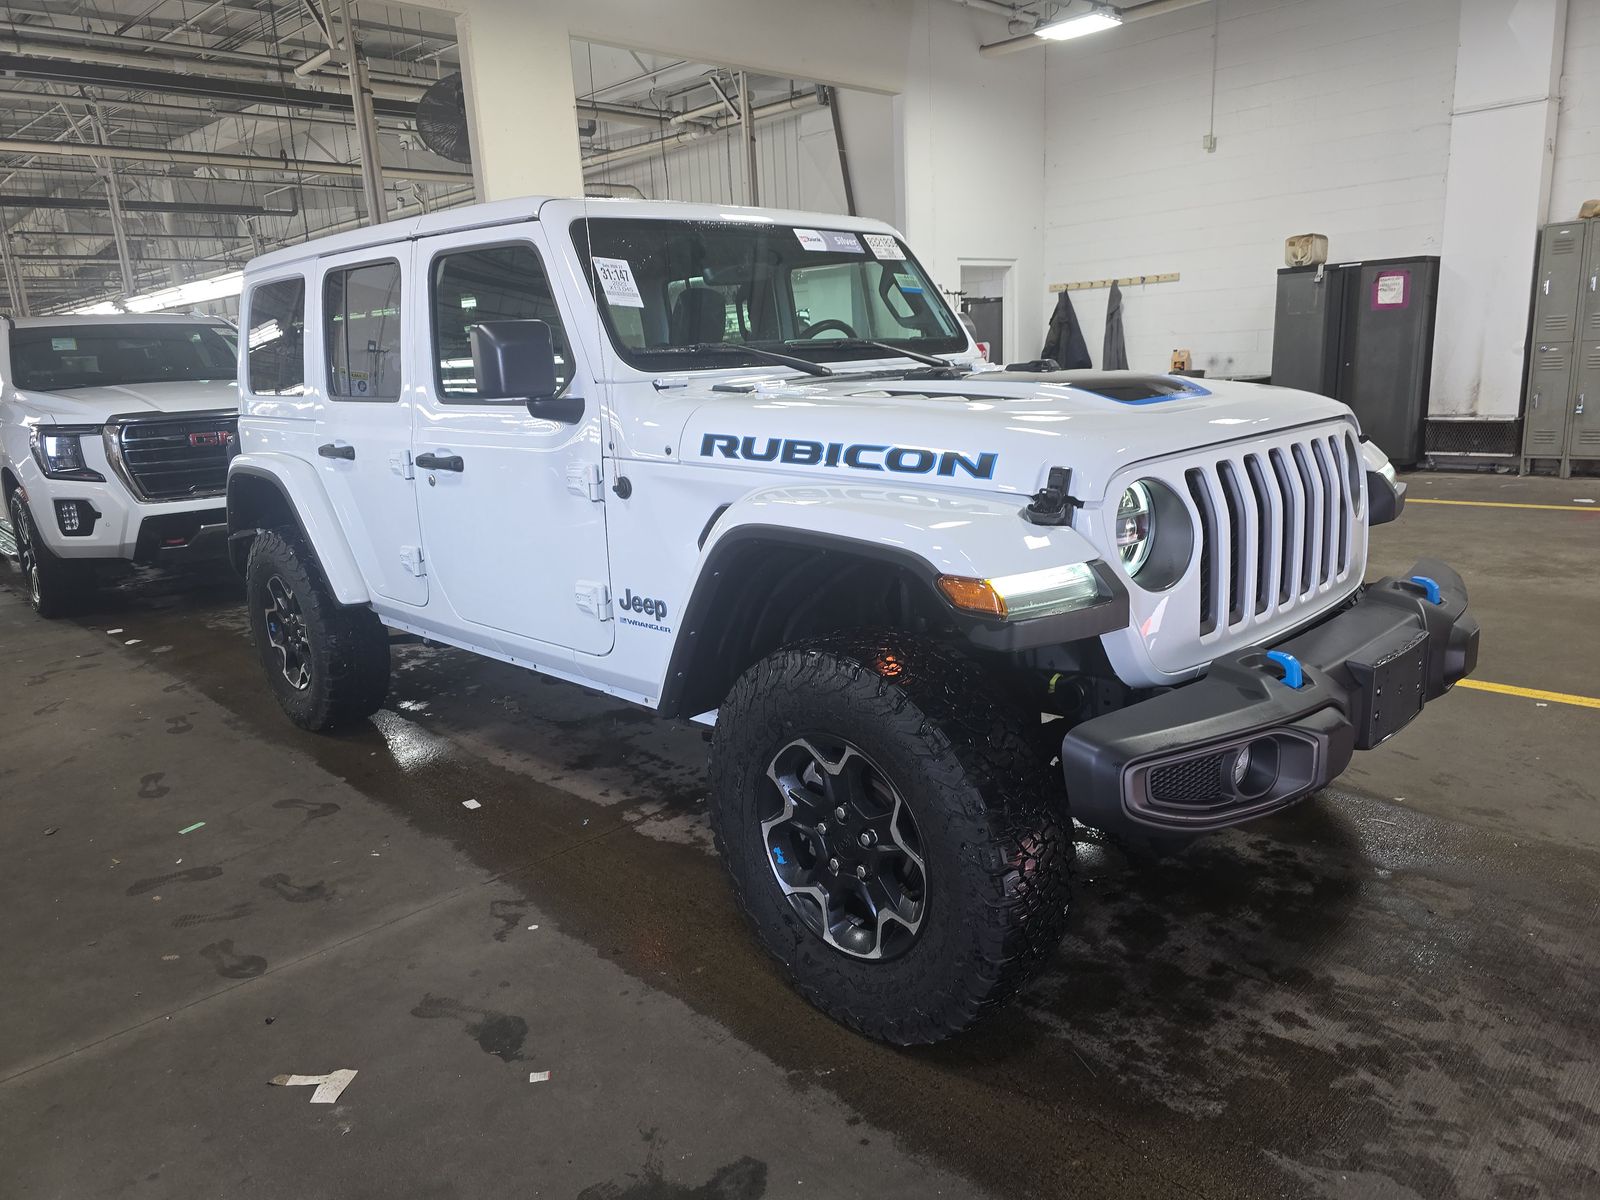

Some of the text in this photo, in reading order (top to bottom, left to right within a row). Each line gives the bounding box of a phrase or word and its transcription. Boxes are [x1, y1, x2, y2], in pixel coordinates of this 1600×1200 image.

[600, 267, 629, 282] 31:147
[699, 432, 999, 480] RUBICON
[618, 588, 668, 622] Jeep
[627, 618, 672, 634] WRANGLER
